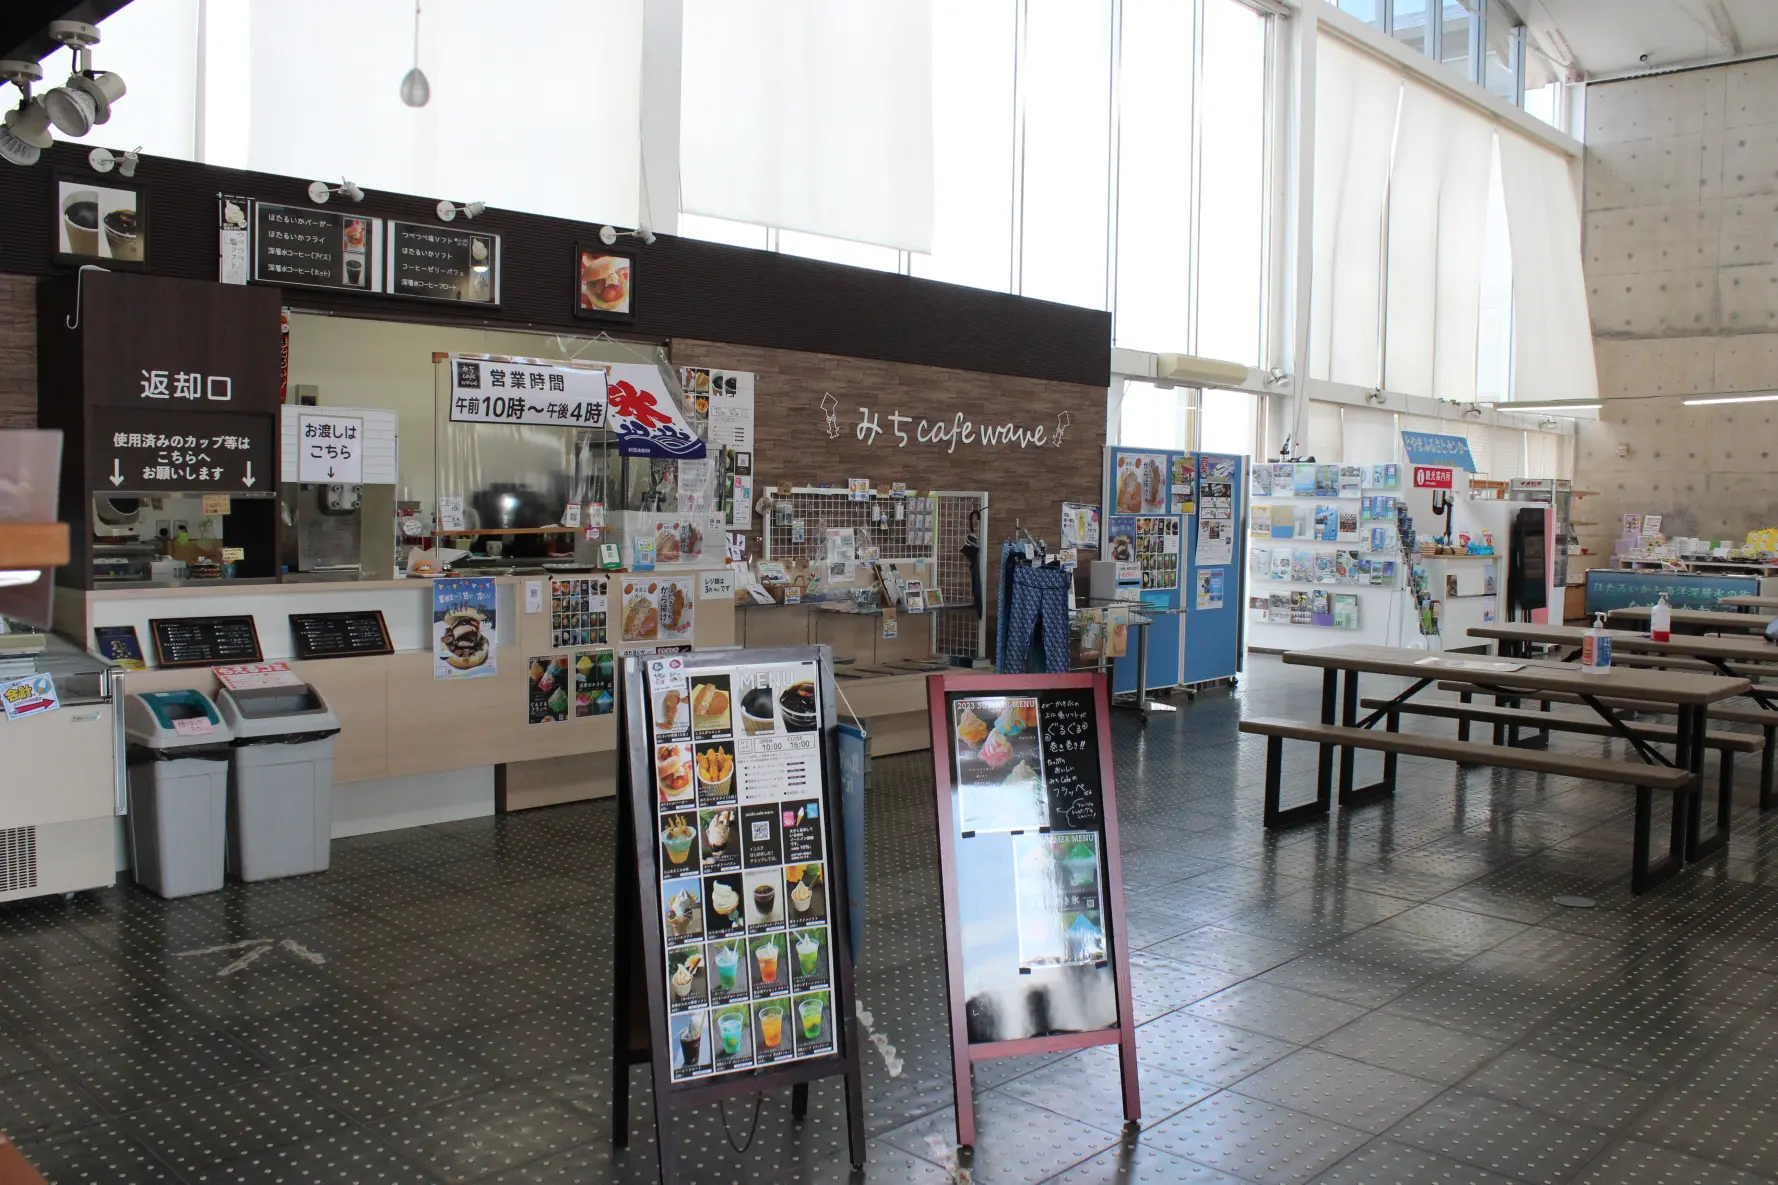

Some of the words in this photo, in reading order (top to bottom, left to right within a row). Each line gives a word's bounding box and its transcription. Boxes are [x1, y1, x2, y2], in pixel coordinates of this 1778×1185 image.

[268, 213, 333, 228] ほたるいかバーガー
[268, 230, 326, 244] ほたるいかフライ
[402, 247, 453, 260] ほたるいかソフト
[402, 263, 465, 277] コーヒーゼリーパフェ
[140, 369, 232, 401] 返却口
[489, 368, 566, 392] 営業時間
[304, 422, 357, 441] お渡しは
[856, 407, 912, 448] みち
[916, 411, 976, 454] cafe
[980, 422, 1047, 449] wave
[113, 432, 251, 451] 使用済みのカップ等は
[157, 451, 211, 464] こちらへ
[310, 444, 352, 460] こちら
[142, 465, 225, 481] お願いします
[1425, 470, 1451, 482] 観光案内所
[660, 586, 668, 622] から揚げ
[740, 670, 795, 690] MENU
[4, 684, 33, 703] 会計
[957, 702, 976, 710] 2023
[1012, 700, 1036, 708] MENU
[1047, 722, 1082, 736] ぐるぐる
[762, 743, 783, 751] 10:00
[790, 740, 810, 748] 16:00
[1054, 766, 1075, 774] おいしい
[1071, 834, 1095, 842] MENU
